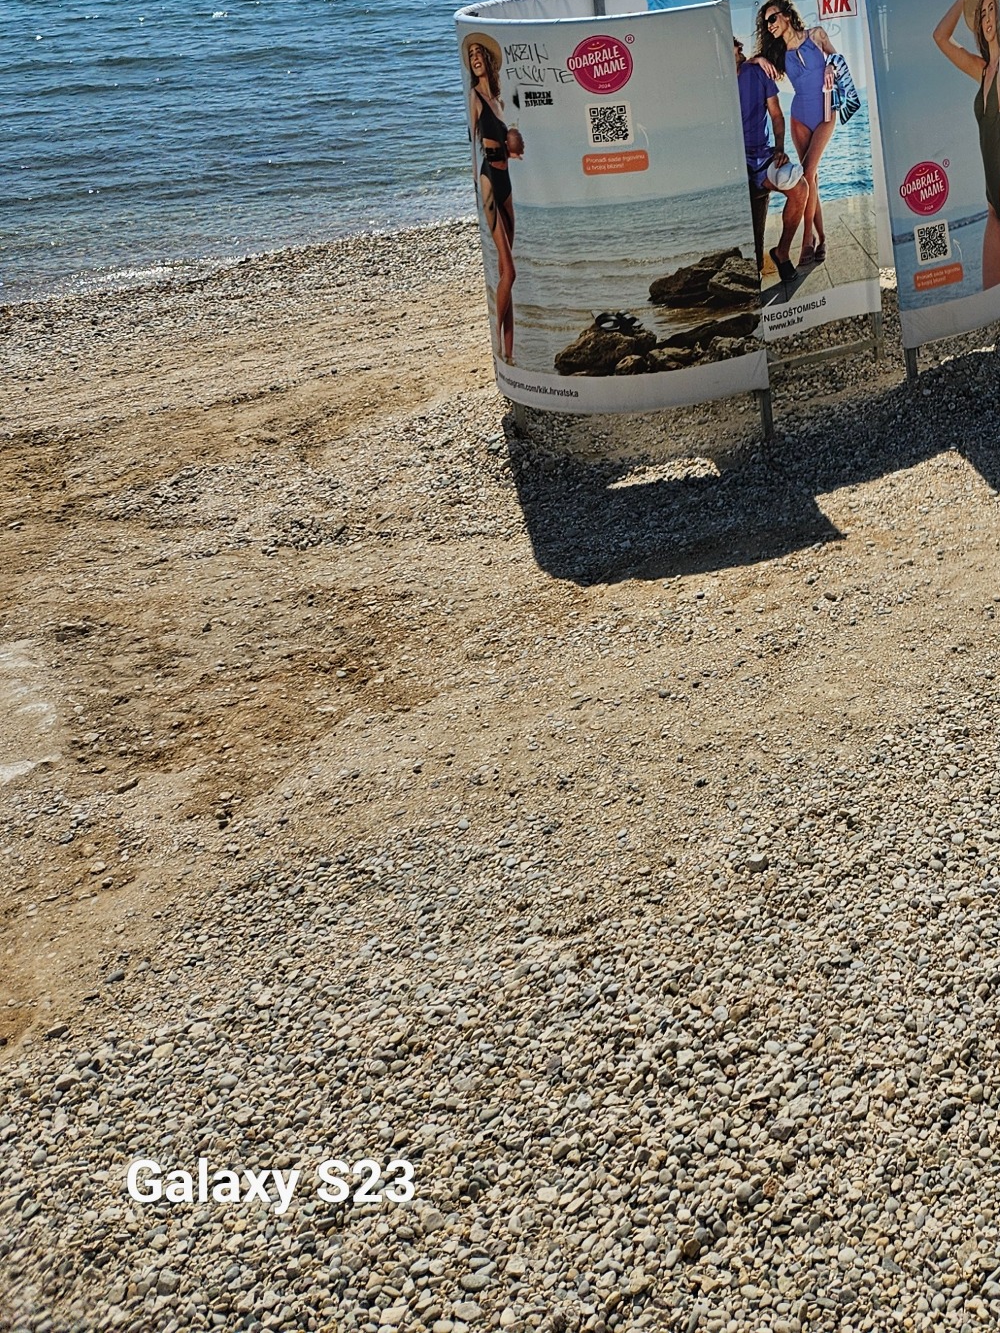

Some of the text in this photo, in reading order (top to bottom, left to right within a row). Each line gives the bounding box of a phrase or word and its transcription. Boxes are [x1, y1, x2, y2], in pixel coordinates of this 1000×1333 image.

[504, 43, 549, 64] MRZIN
[568, 45, 621, 69] ODABRALE
[593, 57, 627, 79] MAME
[900, 169, 941, 197] ODABRALE
[920, 179, 945, 202] MAME
[768, 316, 804, 331] www.kik.hr
